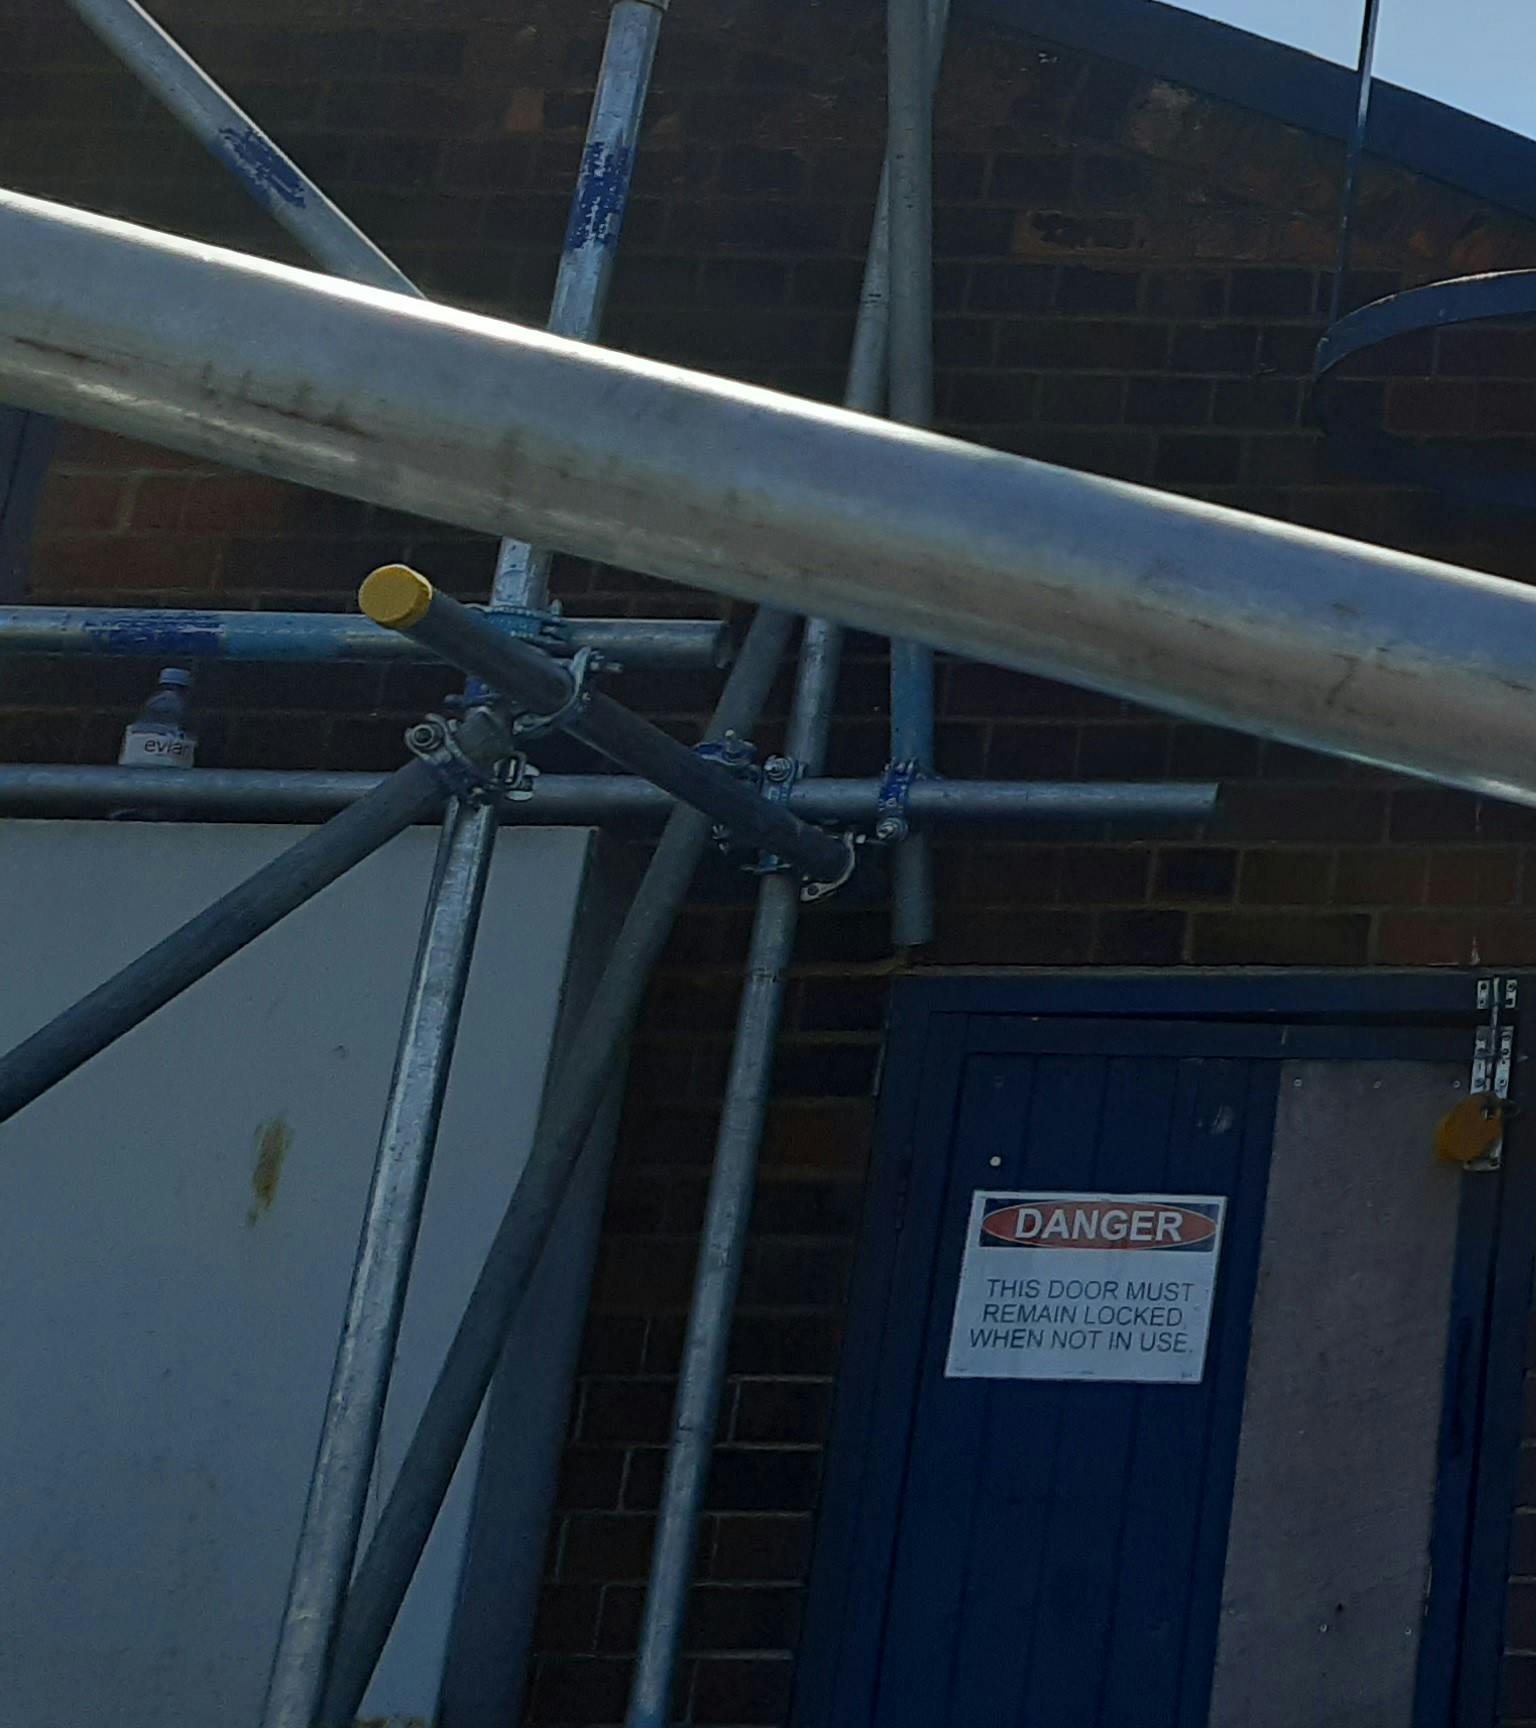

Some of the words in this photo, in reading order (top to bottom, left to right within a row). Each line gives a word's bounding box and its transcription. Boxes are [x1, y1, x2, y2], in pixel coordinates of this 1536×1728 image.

[1014, 1207, 1184, 1243] DANGER
[986, 1278, 1041, 1299] THIS
[1047, 1279, 1119, 1301] DOOR
[1125, 1281, 1196, 1302] MUST
[981, 1303, 1078, 1324] REMAIN
[969, 1328, 1044, 1349] WHEN
[1050, 1329, 1103, 1349] NOT
[1108, 1331, 1133, 1351] IN
[1140, 1332, 1194, 1353] USE.
